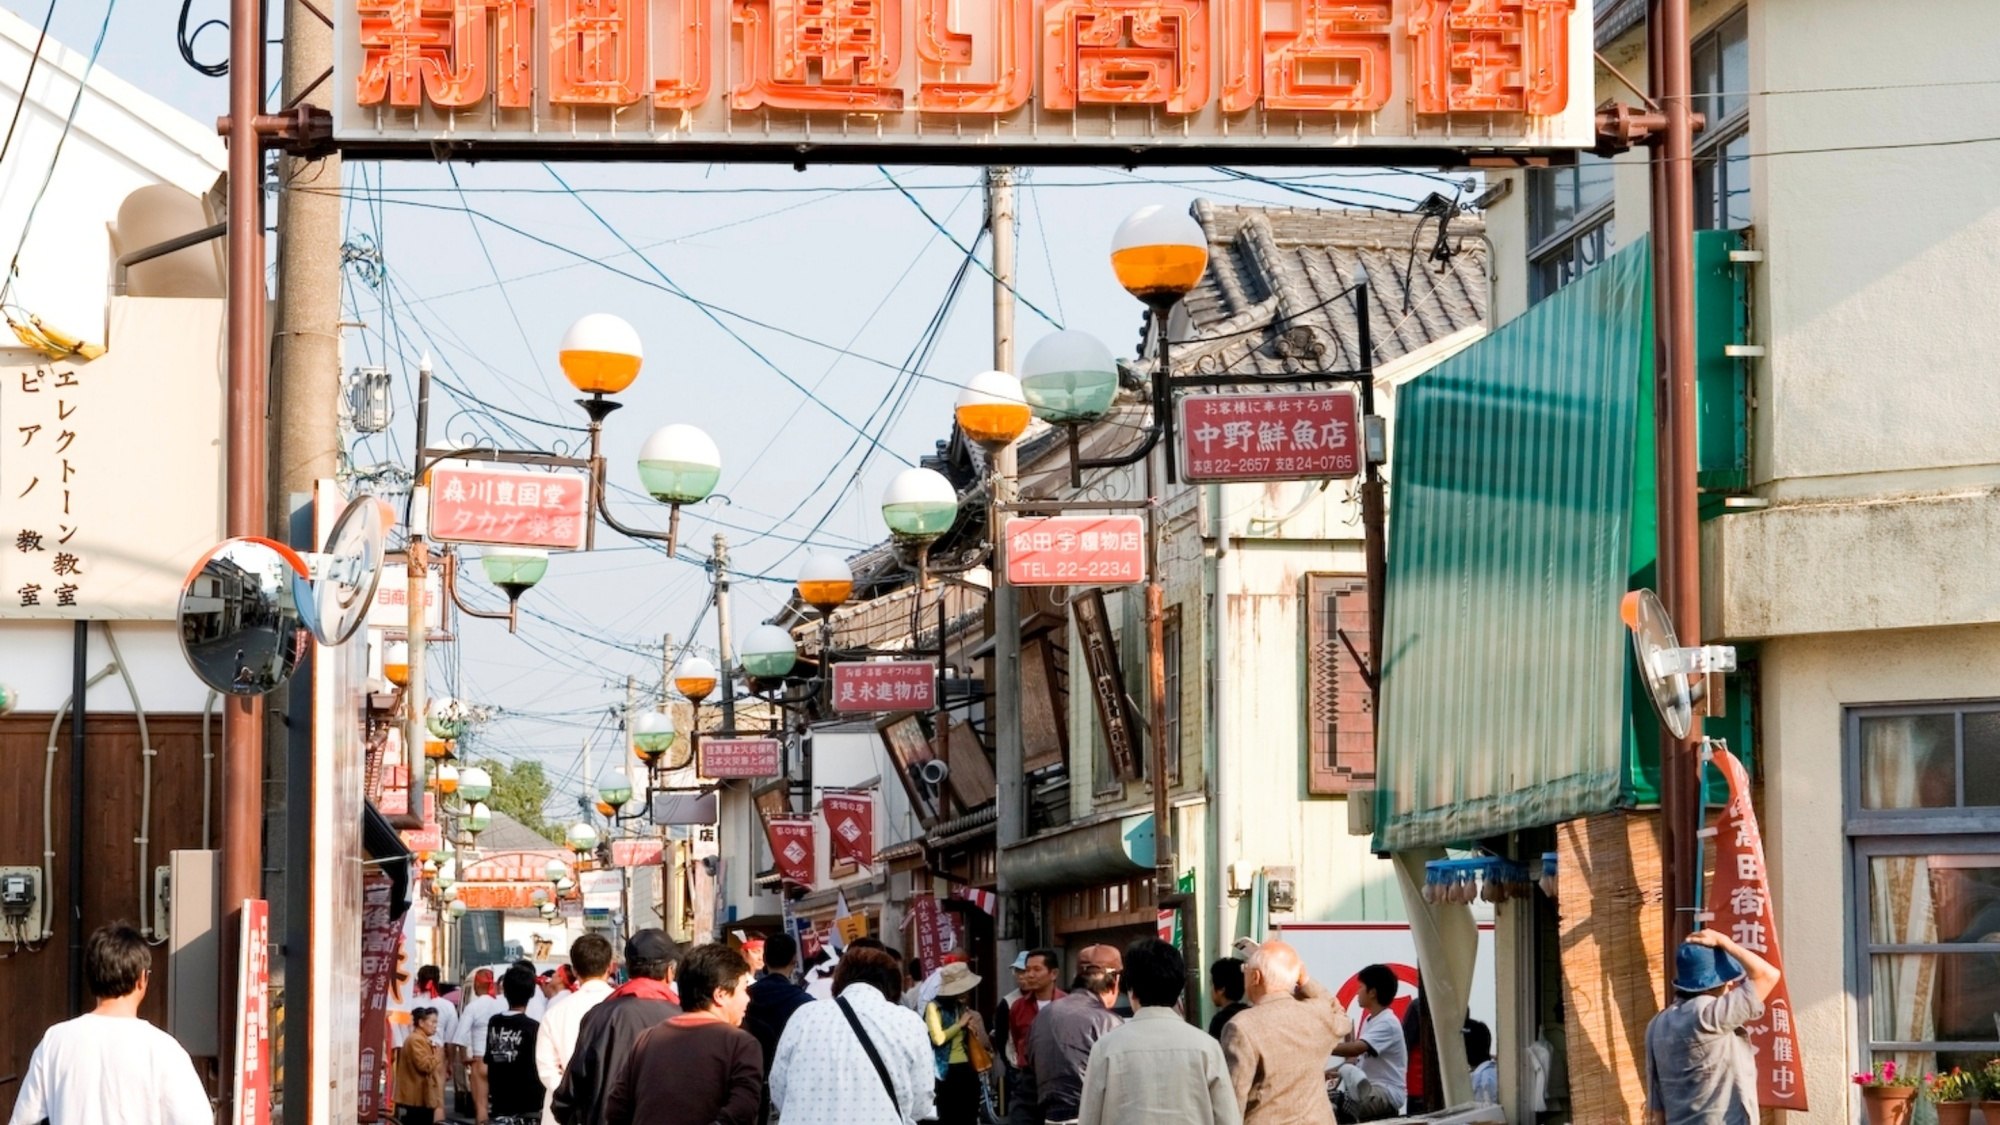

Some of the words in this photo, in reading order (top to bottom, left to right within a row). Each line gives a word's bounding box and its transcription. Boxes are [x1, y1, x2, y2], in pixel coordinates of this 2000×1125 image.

[1204, 399, 1333, 415] お客様に奉仕する店
[1194, 418, 1348, 454] 中野鮮魚店
[16, 371, 45, 607] ピアノ教室
[53, 371, 82, 607] エレクトーン教室
[442, 477, 565, 510] 森川豊国堂
[453, 508, 574, 539] タカダ楽器
[841, 680, 929, 702] 是永進物店
[1771, 998, 1795, 1099] (開催中)
